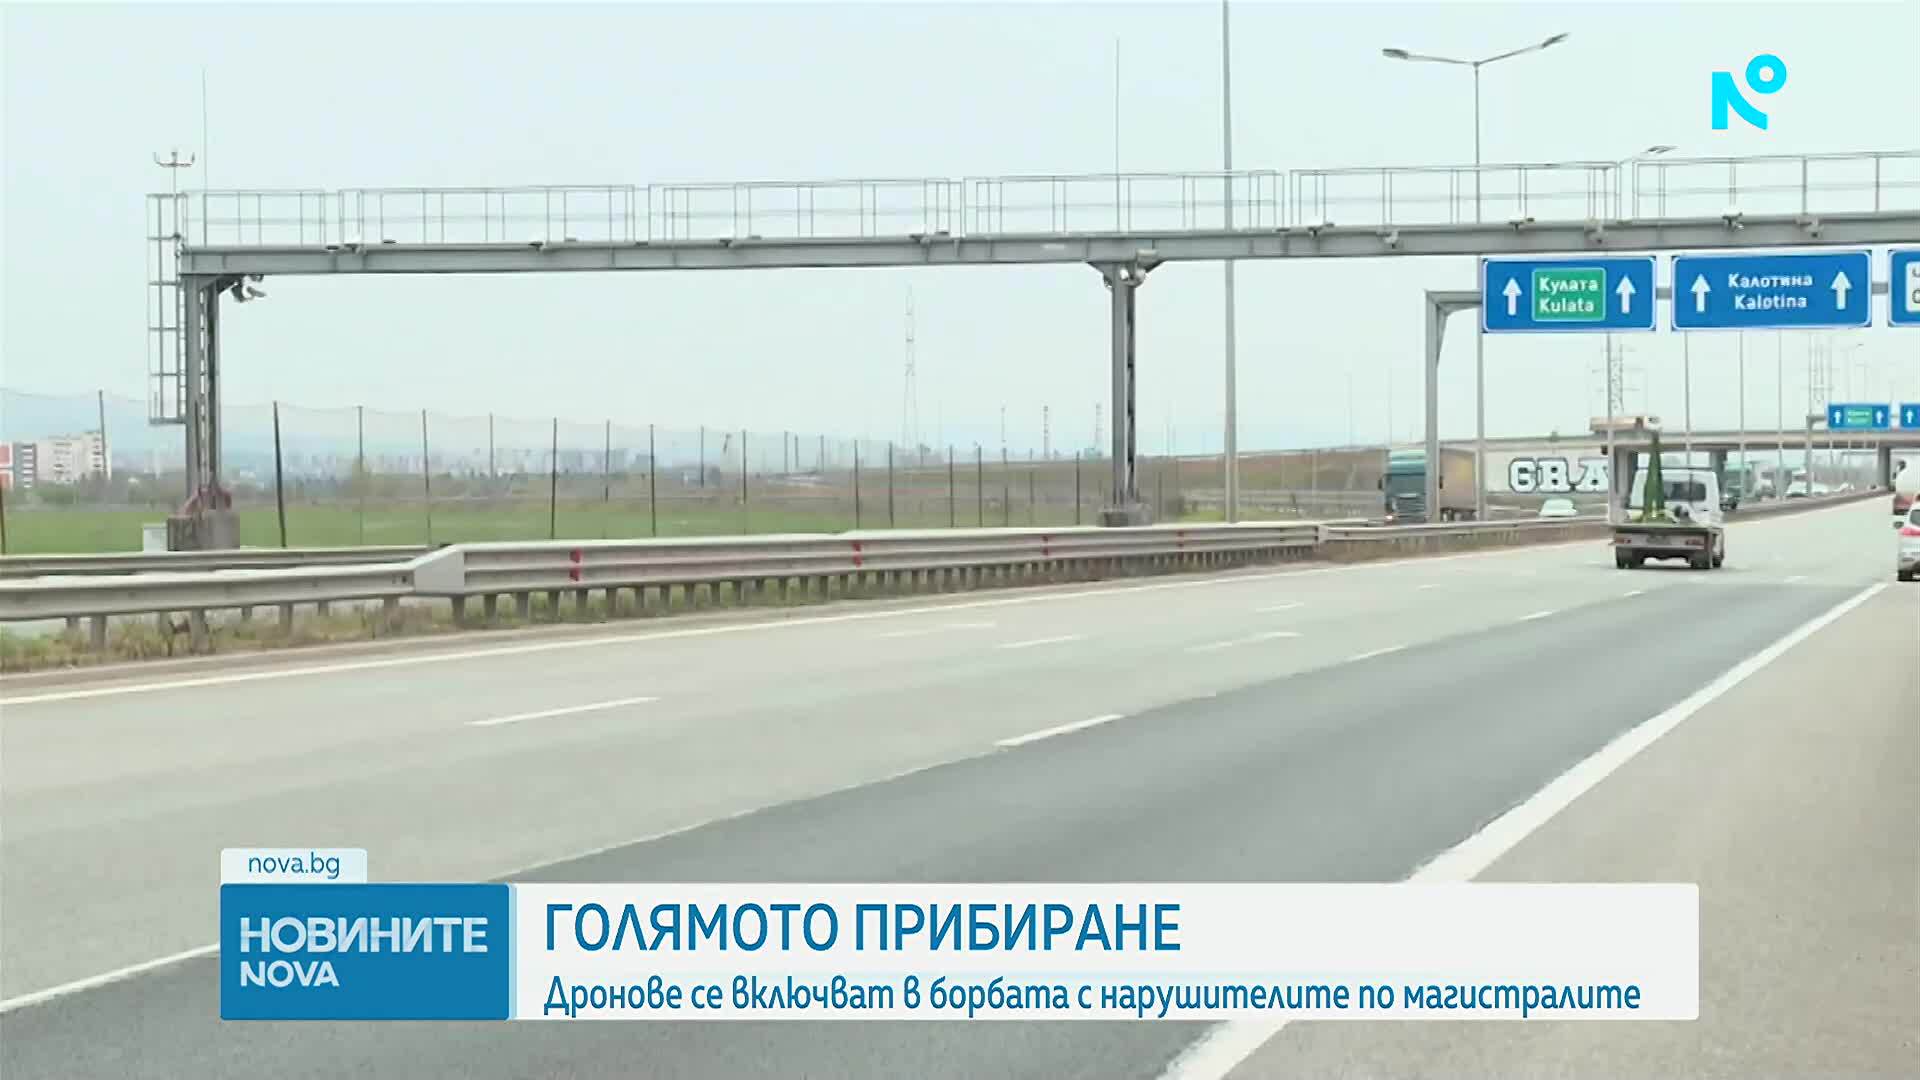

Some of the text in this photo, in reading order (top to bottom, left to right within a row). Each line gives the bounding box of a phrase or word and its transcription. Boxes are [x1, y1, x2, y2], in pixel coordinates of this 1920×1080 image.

[1539, 277, 1600, 295] Кулата
[1728, 273, 1813, 289] Калотина
[1539, 298, 1595, 313] Kulata
[1734, 294, 1808, 310] Kalotina
